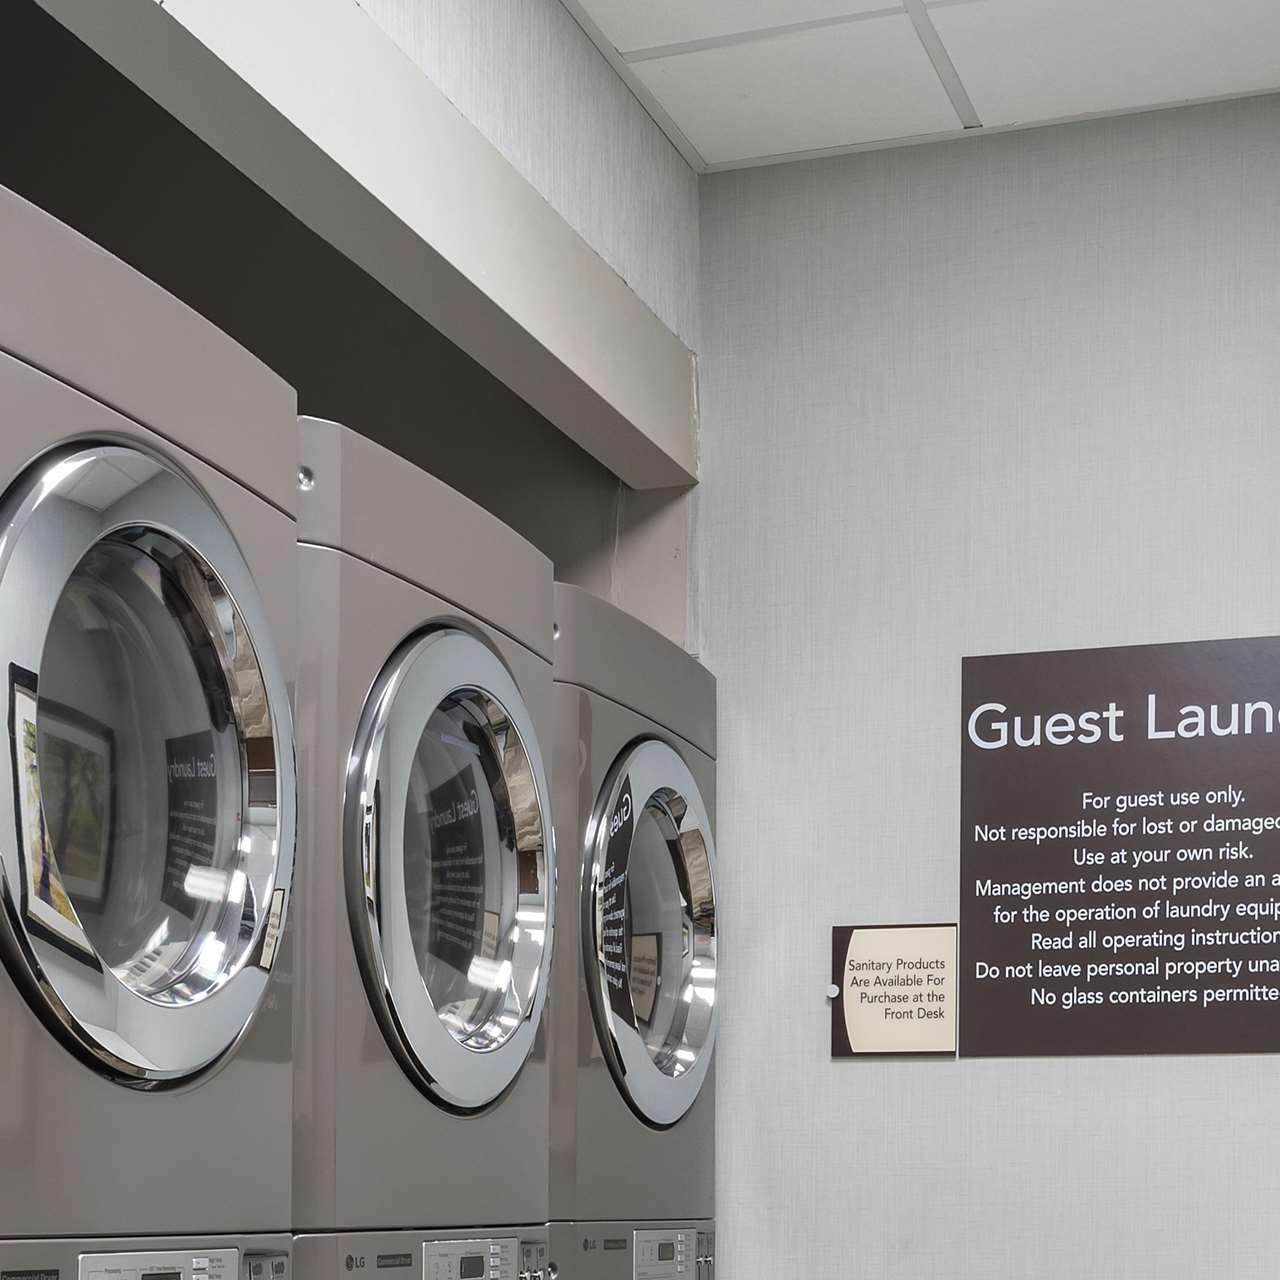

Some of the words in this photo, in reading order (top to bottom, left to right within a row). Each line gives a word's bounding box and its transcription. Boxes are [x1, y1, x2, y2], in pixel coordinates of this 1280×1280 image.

[967, 702, 1125, 749] Guest
[1082, 791, 1112, 810] For
[1115, 790, 1165, 813] guest
[1170, 791, 1201, 806] use
[1205, 783, 1246, 808] only.
[974, 824, 1007, 842] Not
[1011, 818, 1108, 846] responsible
[1111, 817, 1138, 837] for
[1142, 816, 1174, 835] lost
[1178, 819, 1199, 834] or
[1073, 847, 1106, 866] Use
[1110, 848, 1128, 865] at
[1132, 849, 1172, 869] your
[1176, 847, 1213, 862] own
[1218, 840, 1254, 860] risk.
[975, 877, 1086, 900] Management
[1091, 874, 1133, 893] does
[1138, 874, 1168, 892] not
[1172, 869, 1240, 896] provide
[1244, 873, 1266, 888] an
[993, 905, 1018, 924] for
[1021, 904, 1050, 923] the
[1054, 902, 1137, 927] operation
[1142, 899, 1161, 919] of
[1165, 898, 1231, 922] laundry
[1031, 930, 1073, 950] Read
[1078, 929, 1097, 949] all
[1102, 929, 1186, 954] operating
[848, 959, 893, 974] Sanitary
[896, 957, 946, 971] Products
[975, 961, 1000, 979] Do
[1005, 962, 1033, 978] not
[1038, 959, 1082, 978] leave
[1086, 956, 1160, 982] personal
[1165, 957, 1243, 981] property
[849, 975, 871, 988] Are
[873, 974, 924, 987] Available
[926, 973, 945, 986] For
[860, 991, 909, 1004] Purchase
[912, 992, 924, 1003] at
[926, 990, 945, 1003] the
[1031, 987, 1057, 1006] No
[1061, 986, 1104, 1010] glass
[1108, 985, 1198, 1004] containers
[884, 1007, 914, 1020] Front
[917, 1006, 945, 1020] Desk
